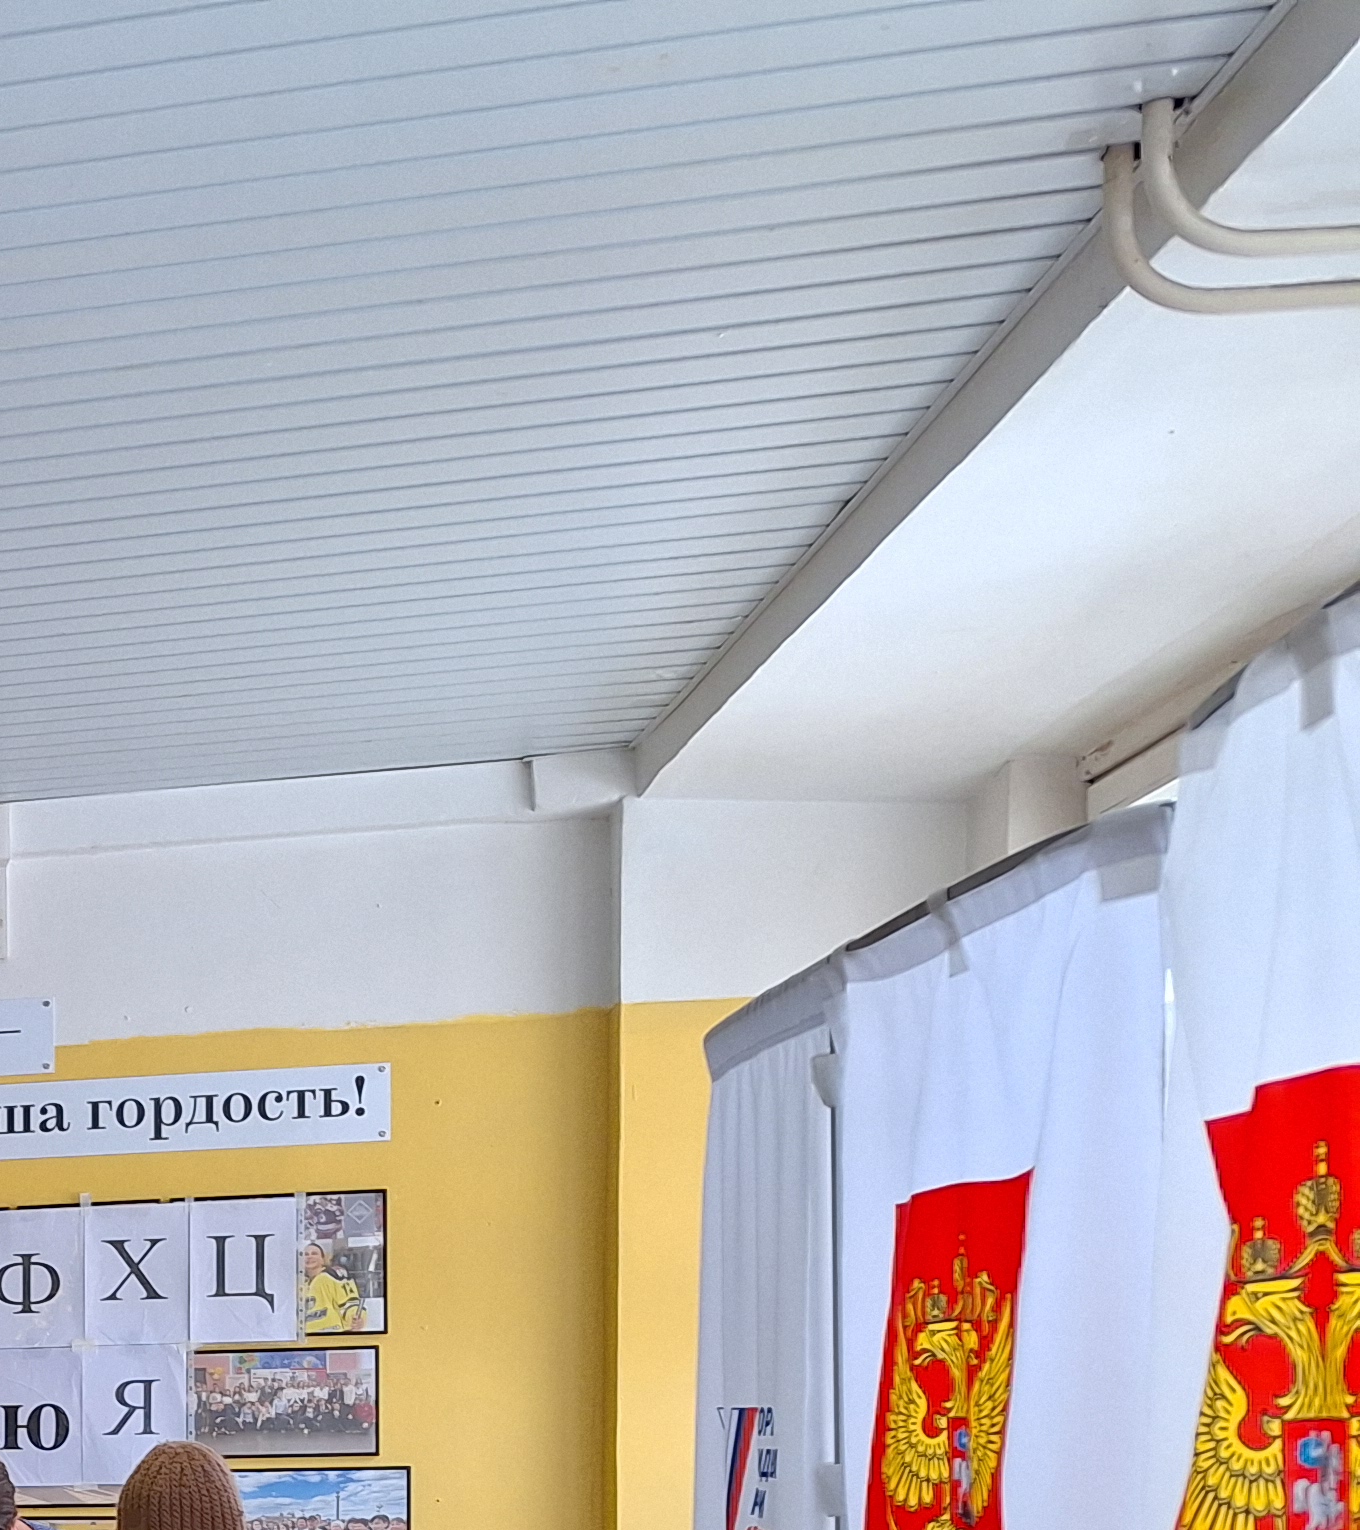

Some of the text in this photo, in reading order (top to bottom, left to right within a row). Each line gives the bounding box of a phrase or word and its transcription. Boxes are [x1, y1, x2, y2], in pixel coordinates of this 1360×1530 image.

[85, 1075, 366, 1141] гордость!
[100, 1238, 169, 1301] Х
[206, 1233, 276, 1314] Ц
[102, 1378, 161, 1436] Я
